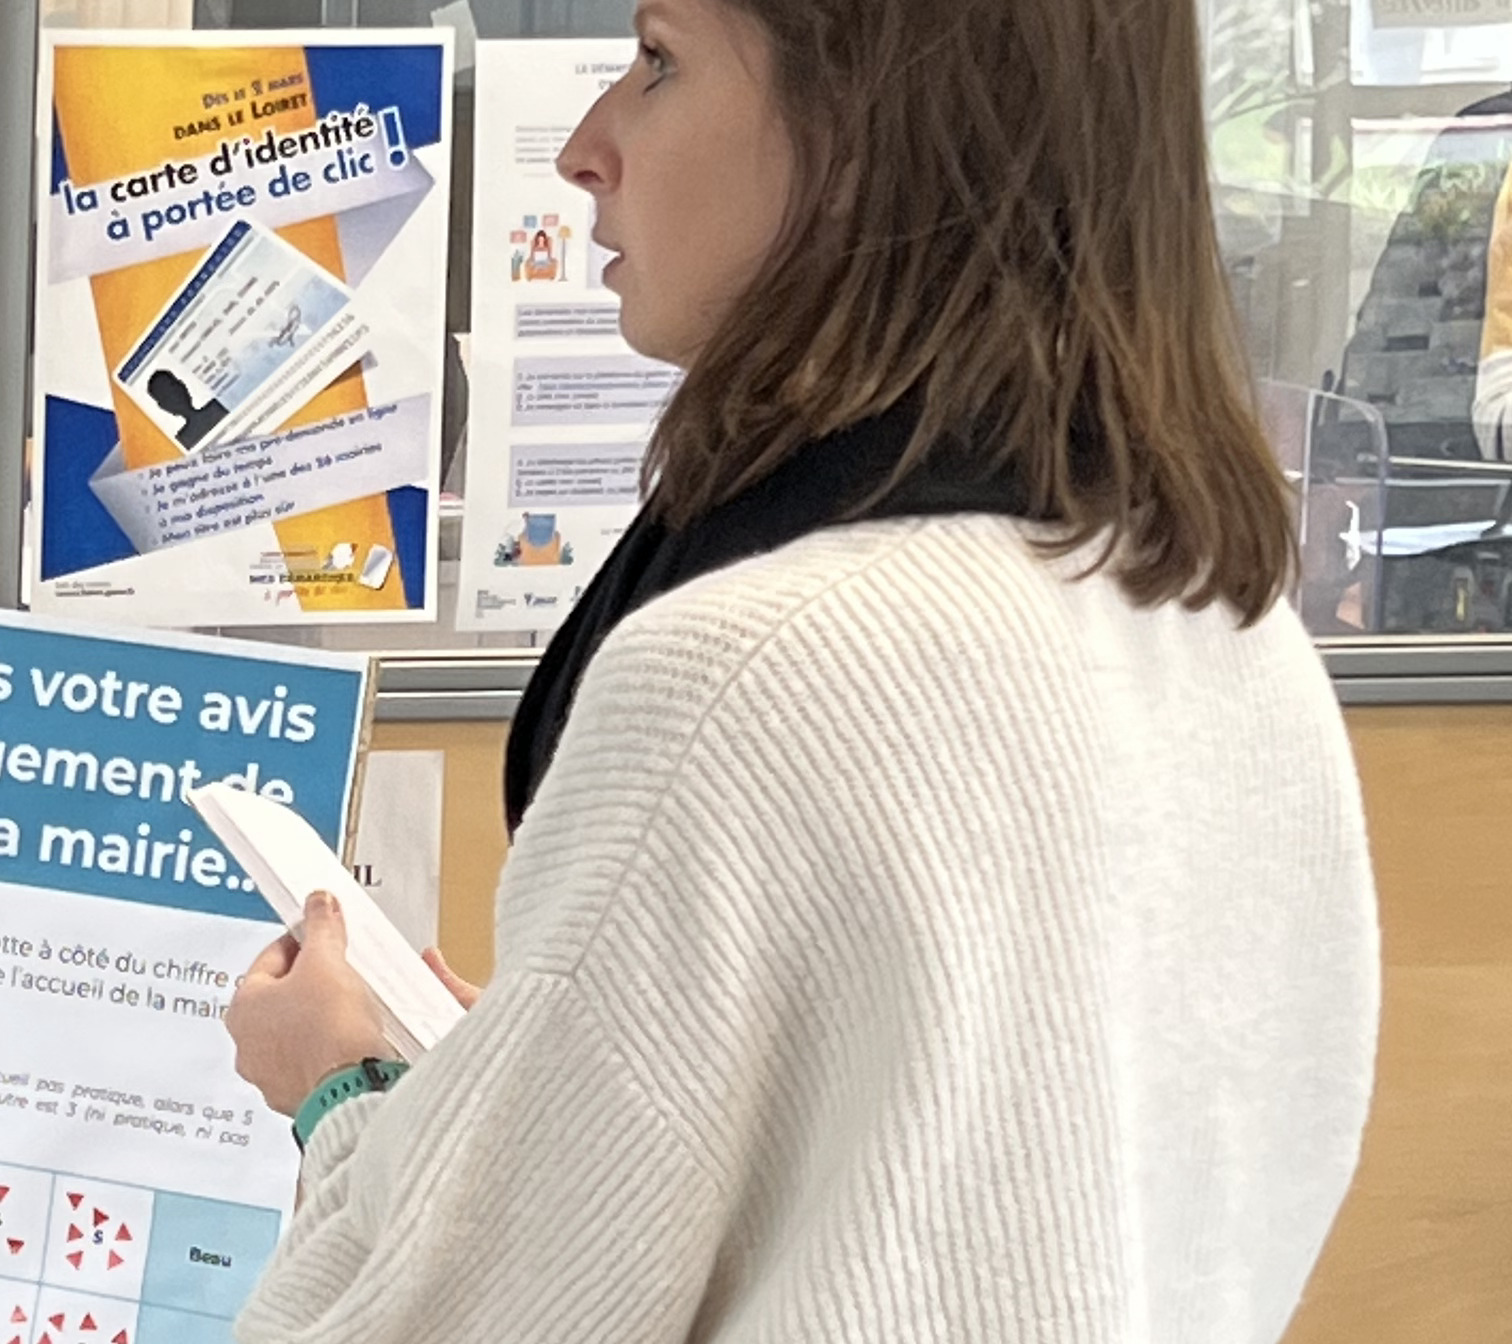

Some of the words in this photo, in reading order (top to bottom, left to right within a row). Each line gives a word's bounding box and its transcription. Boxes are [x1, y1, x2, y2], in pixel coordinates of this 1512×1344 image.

[173, 116, 221, 140] DANS
[63, 184, 98, 216] la
[110, 162, 198, 203] carte
[210, 106, 376, 177] d'identité
[106, 208, 130, 241] à
[142, 180, 256, 242] portée
[268, 165, 312, 199] de
[323, 147, 375, 184] clic
[213, 466, 231, 478] du
[30, 667, 183, 726] votre
[199, 685, 317, 742] avis
[39, 940, 52, 960] à
[59, 945, 110, 970] côté
[115, 950, 146, 975] du
[154, 957, 230, 988] chiffre
[11, 966, 104, 1001] l'accueil
[109, 984, 139, 1007] de
[146, 987, 166, 1012] la
[172, 995, 228, 1019] mair
[35, 1078, 65, 1094] pas
[153, 1097, 195, 1116] alors
[202, 1106, 234, 1122] que
[35, 1101, 59, 1115] est
[65, 1101, 78, 1118] 3
[195, 1125, 213, 1140] ni
[218, 1131, 251, 1147] pas
[92, 1229, 104, 1245] 5
[189, 1246, 232, 1268] Beau
